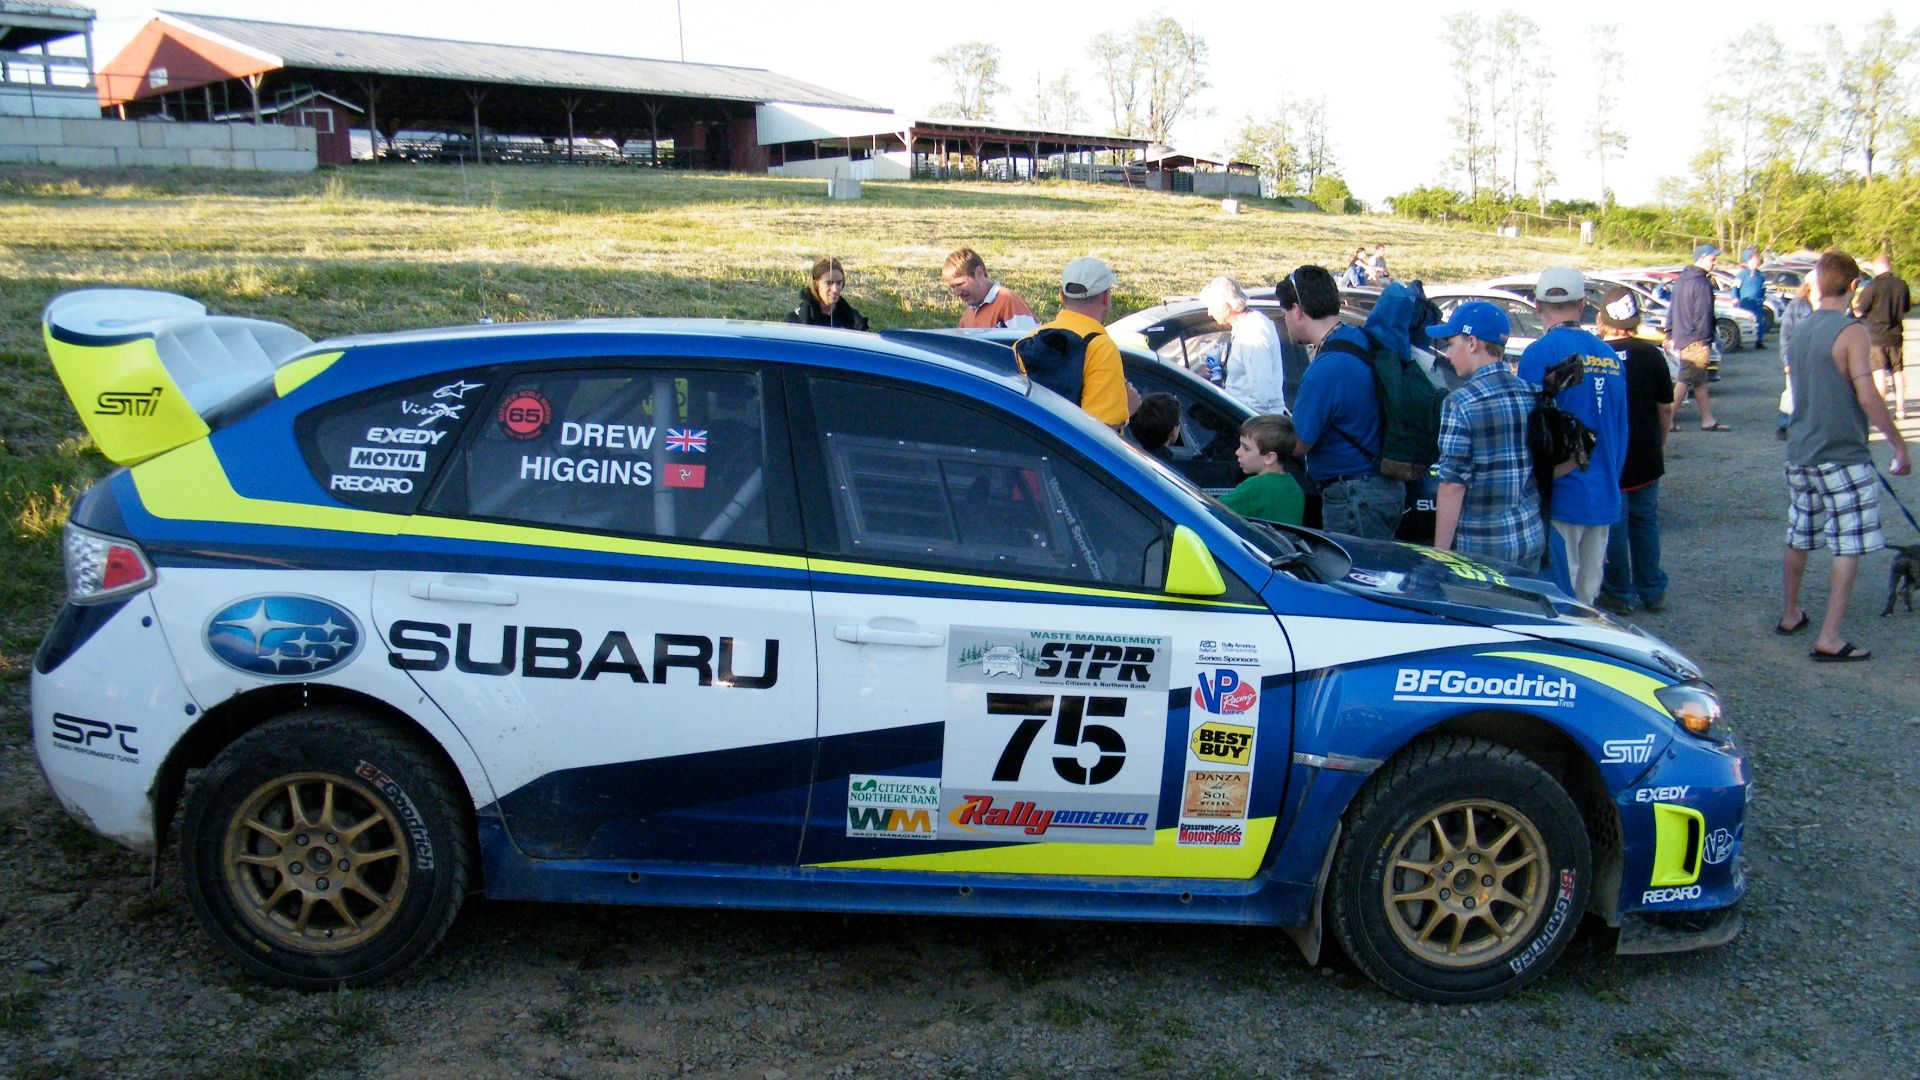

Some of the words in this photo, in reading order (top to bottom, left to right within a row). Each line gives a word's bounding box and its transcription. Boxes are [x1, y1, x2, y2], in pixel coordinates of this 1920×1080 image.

[509, 408, 540, 424] 65
[366, 427, 448, 446] EXEDY
[560, 422, 657, 450] DREW
[353, 450, 423, 469] MOTUL
[520, 456, 653, 488] HIGGINS
[330, 474, 414, 495] RECARO
[1030, 631, 1072, 641] WASTE
[1075, 634, 1162, 646] MANAGEMENT
[388, 619, 780, 689] SUBARU
[1034, 642, 1155, 683] STPR
[1198, 654, 1222, 662] Series
[1223, 656, 1259, 664] Sponsors
[1197, 669, 1239, 714] VP
[1395, 668, 1577, 699] BFGoodrich
[1222, 693, 1257, 710] Racing
[1558, 699, 1575, 708] Tires
[52, 712, 139, 755] SPT
[987, 692, 1127, 785] 75
[1199, 729, 1252, 746] BEST
[1200, 742, 1248, 759] BUY
[1196, 773, 1241, 782] DANZA
[850, 792, 908, 804] NORTHERN
[911, 795, 938, 805] BANK
[878, 783, 927, 795] CITIZENS
[929, 785, 937, 795] &
[1635, 785, 1690, 803] EXEDY
[849, 807, 932, 833] WM
[959, 795, 1054, 835] Rally
[1053, 809, 1149, 826] AMERICA
[1180, 823, 1216, 831] Grassroots
[1178, 830, 1242, 845] Motorsports
[1641, 885, 1702, 904] RECARO
